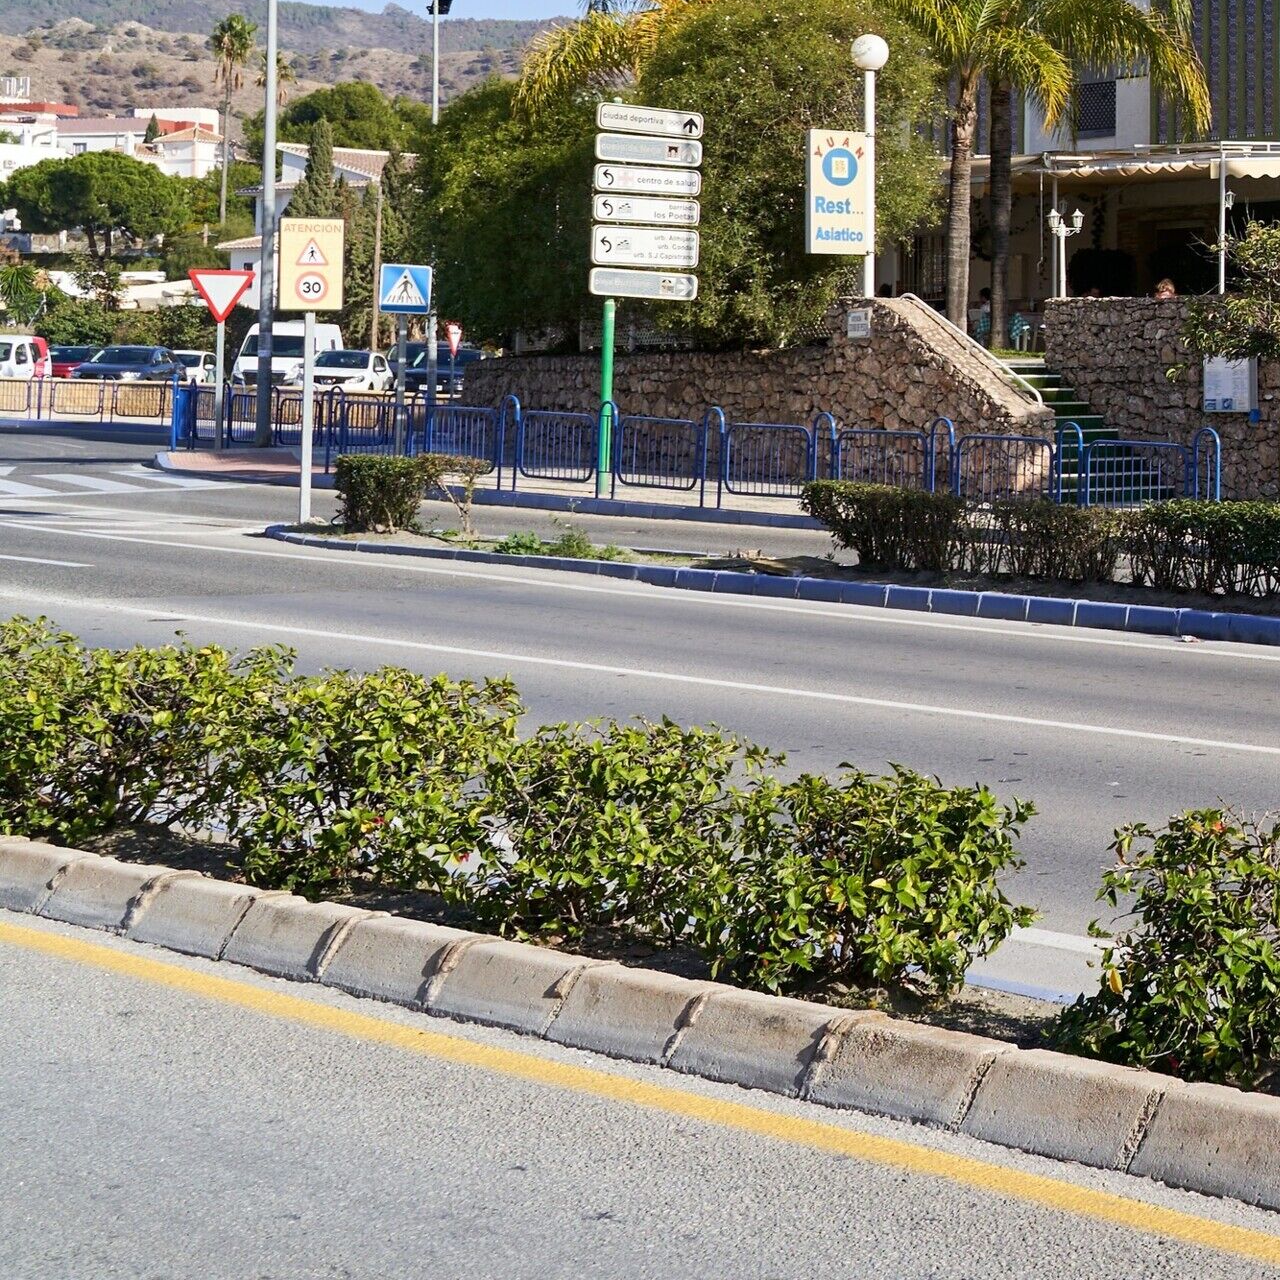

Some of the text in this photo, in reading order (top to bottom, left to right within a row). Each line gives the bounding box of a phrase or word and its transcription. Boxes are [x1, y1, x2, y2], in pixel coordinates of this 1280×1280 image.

[602, 112, 664, 125] ciudad deportiva
[814, 136, 864, 159] YUAN
[637, 177, 697, 187] centro de salud
[668, 212, 695, 220] Poetas
[815, 225, 864, 242] Asiatico
[302, 281, 322, 294] 30
